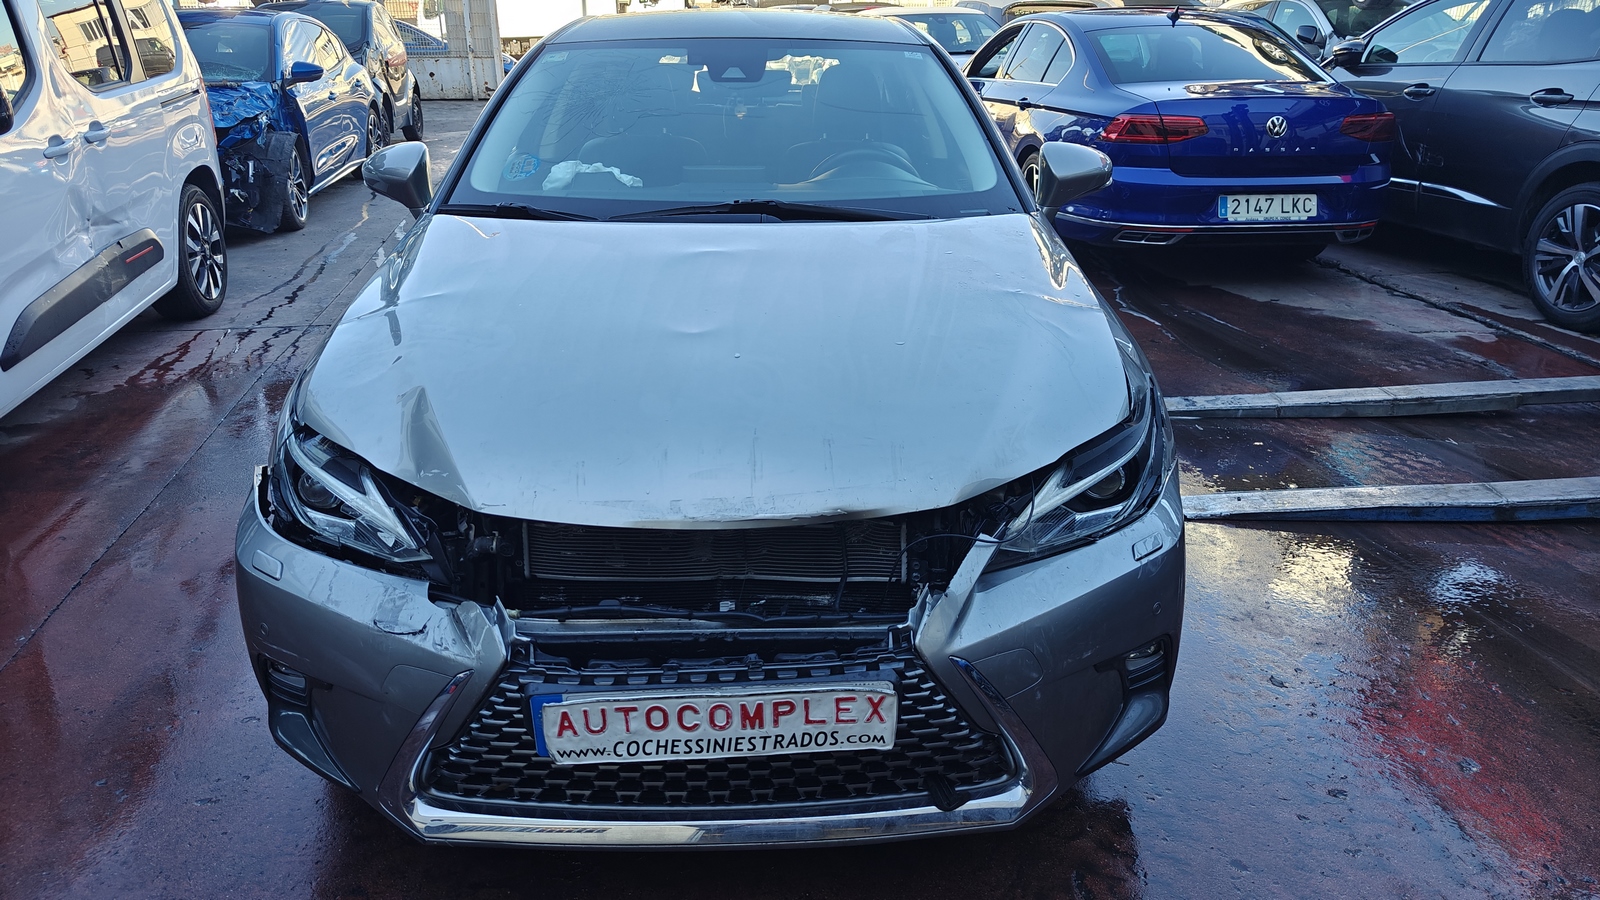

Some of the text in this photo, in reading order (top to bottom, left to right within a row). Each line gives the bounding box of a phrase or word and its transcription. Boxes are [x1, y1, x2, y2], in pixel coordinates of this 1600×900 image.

[1231, 197, 1312, 215] 2147 LKC
[557, 696, 886, 737] AUTOCOMPLEX
